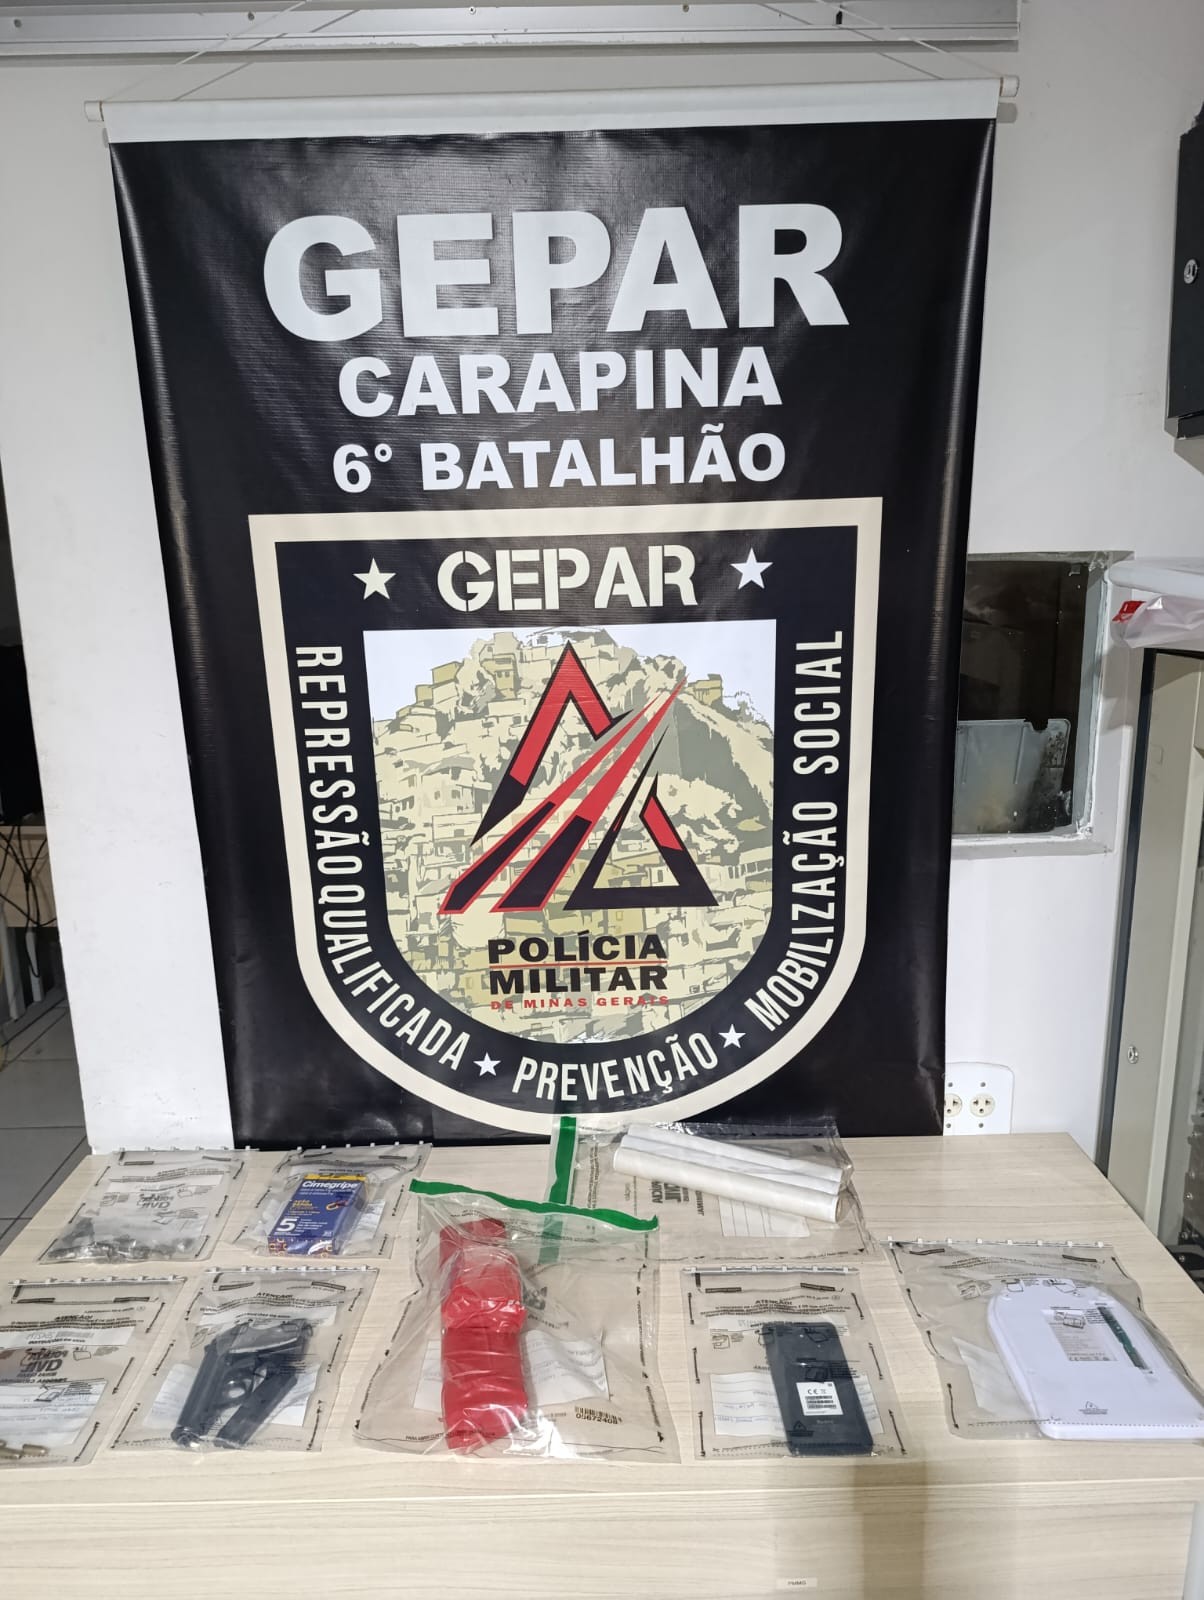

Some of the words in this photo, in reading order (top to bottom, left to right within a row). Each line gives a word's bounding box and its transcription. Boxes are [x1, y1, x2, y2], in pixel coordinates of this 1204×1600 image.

[263, 203, 849, 342] GEPAR
[338, 346, 782, 417] CARAPINA
[420, 423, 785, 491] BATALHÃO
[437, 544, 698, 612] GEPAR
[792, 631, 843, 775] SOCIAL
[488, 930, 667, 963] POLÍCIA
[744, 801, 845, 1032] MOBILIZAÇÃO
[490, 966, 667, 995] MILITAR
[491, 1001, 513, 1010] DE
[524, 998, 588, 1009] MINAS
[597, 996, 670, 1006] GERAIS
[512, 1032, 718, 1101] PREVENÇÃO
[302, 1181, 359, 1191] Cimegripe
[276, 1218, 298, 1232] 5
